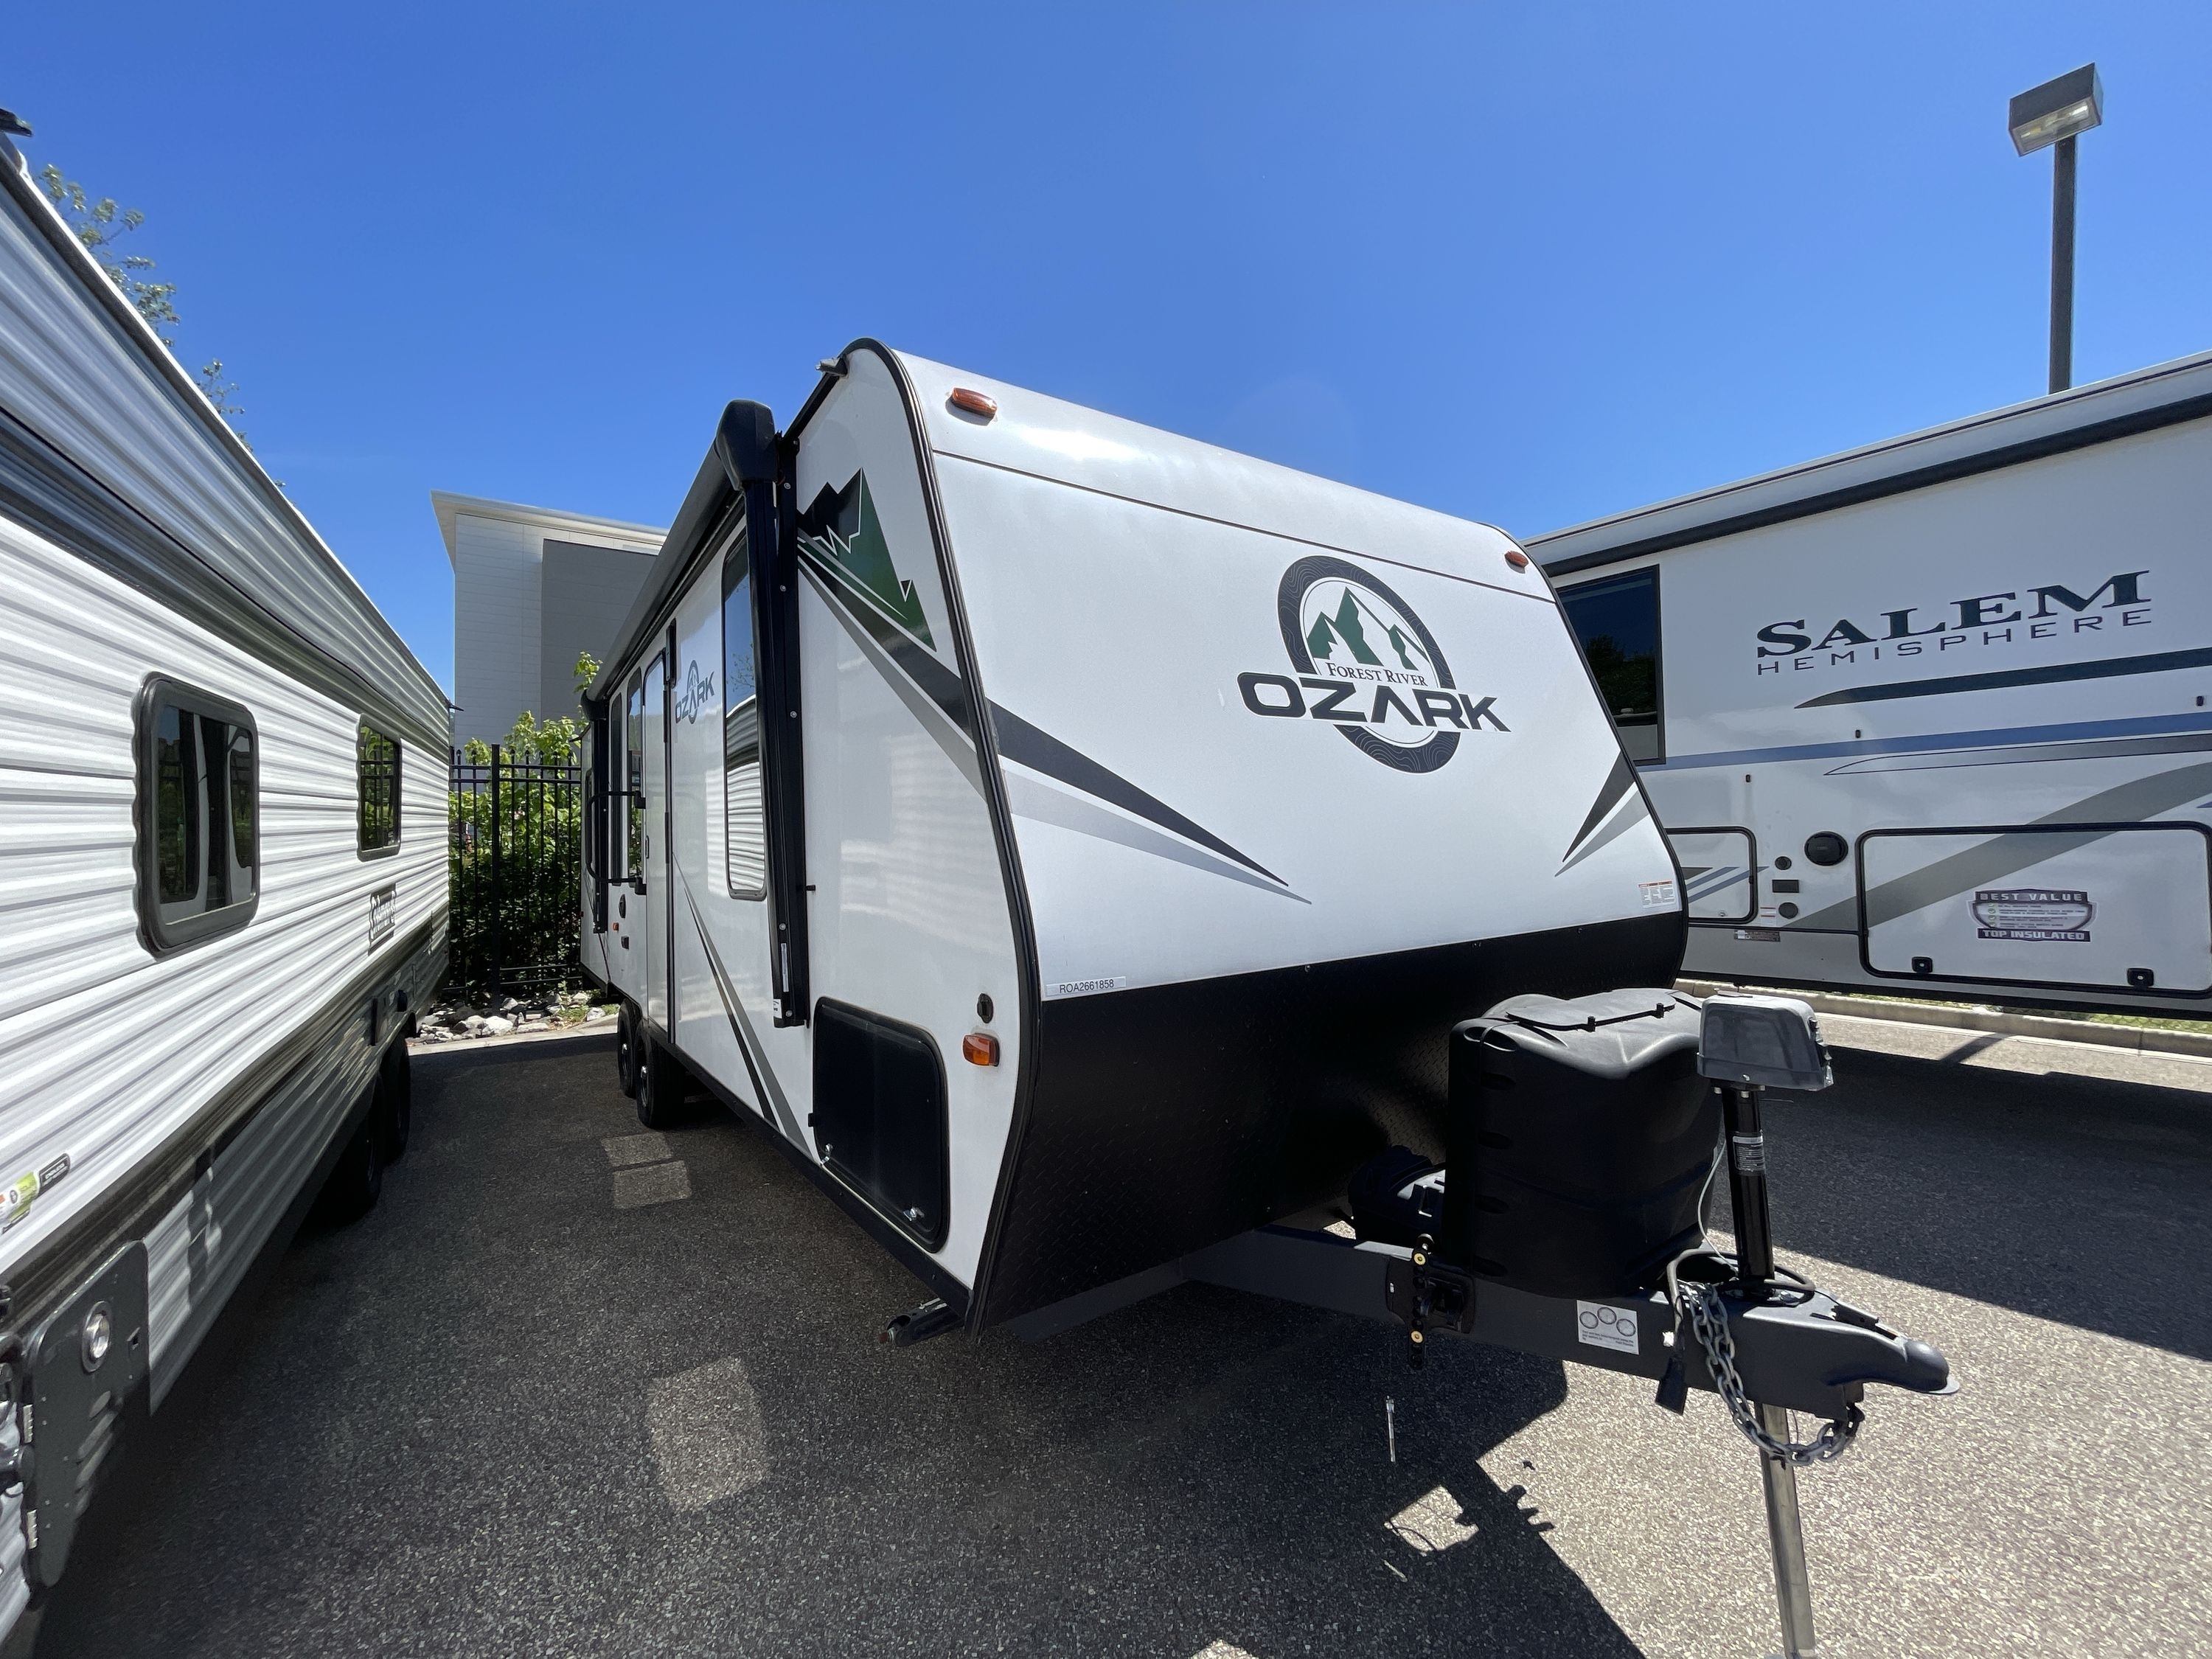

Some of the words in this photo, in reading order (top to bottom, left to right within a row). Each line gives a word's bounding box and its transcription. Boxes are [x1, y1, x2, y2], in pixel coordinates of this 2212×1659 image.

[1757, 570, 2152, 658] SALEM
[1757, 608, 2152, 675] HEMISPHERE
[675, 671, 714, 724] OZARK
[1237, 672, 1512, 732] OZARK
[1980, 893, 2020, 901] BEST
[2029, 893, 2082, 902] VALUE
[1983, 930, 2007, 938] TOP
[2011, 931, 2085, 940] INSULATED
